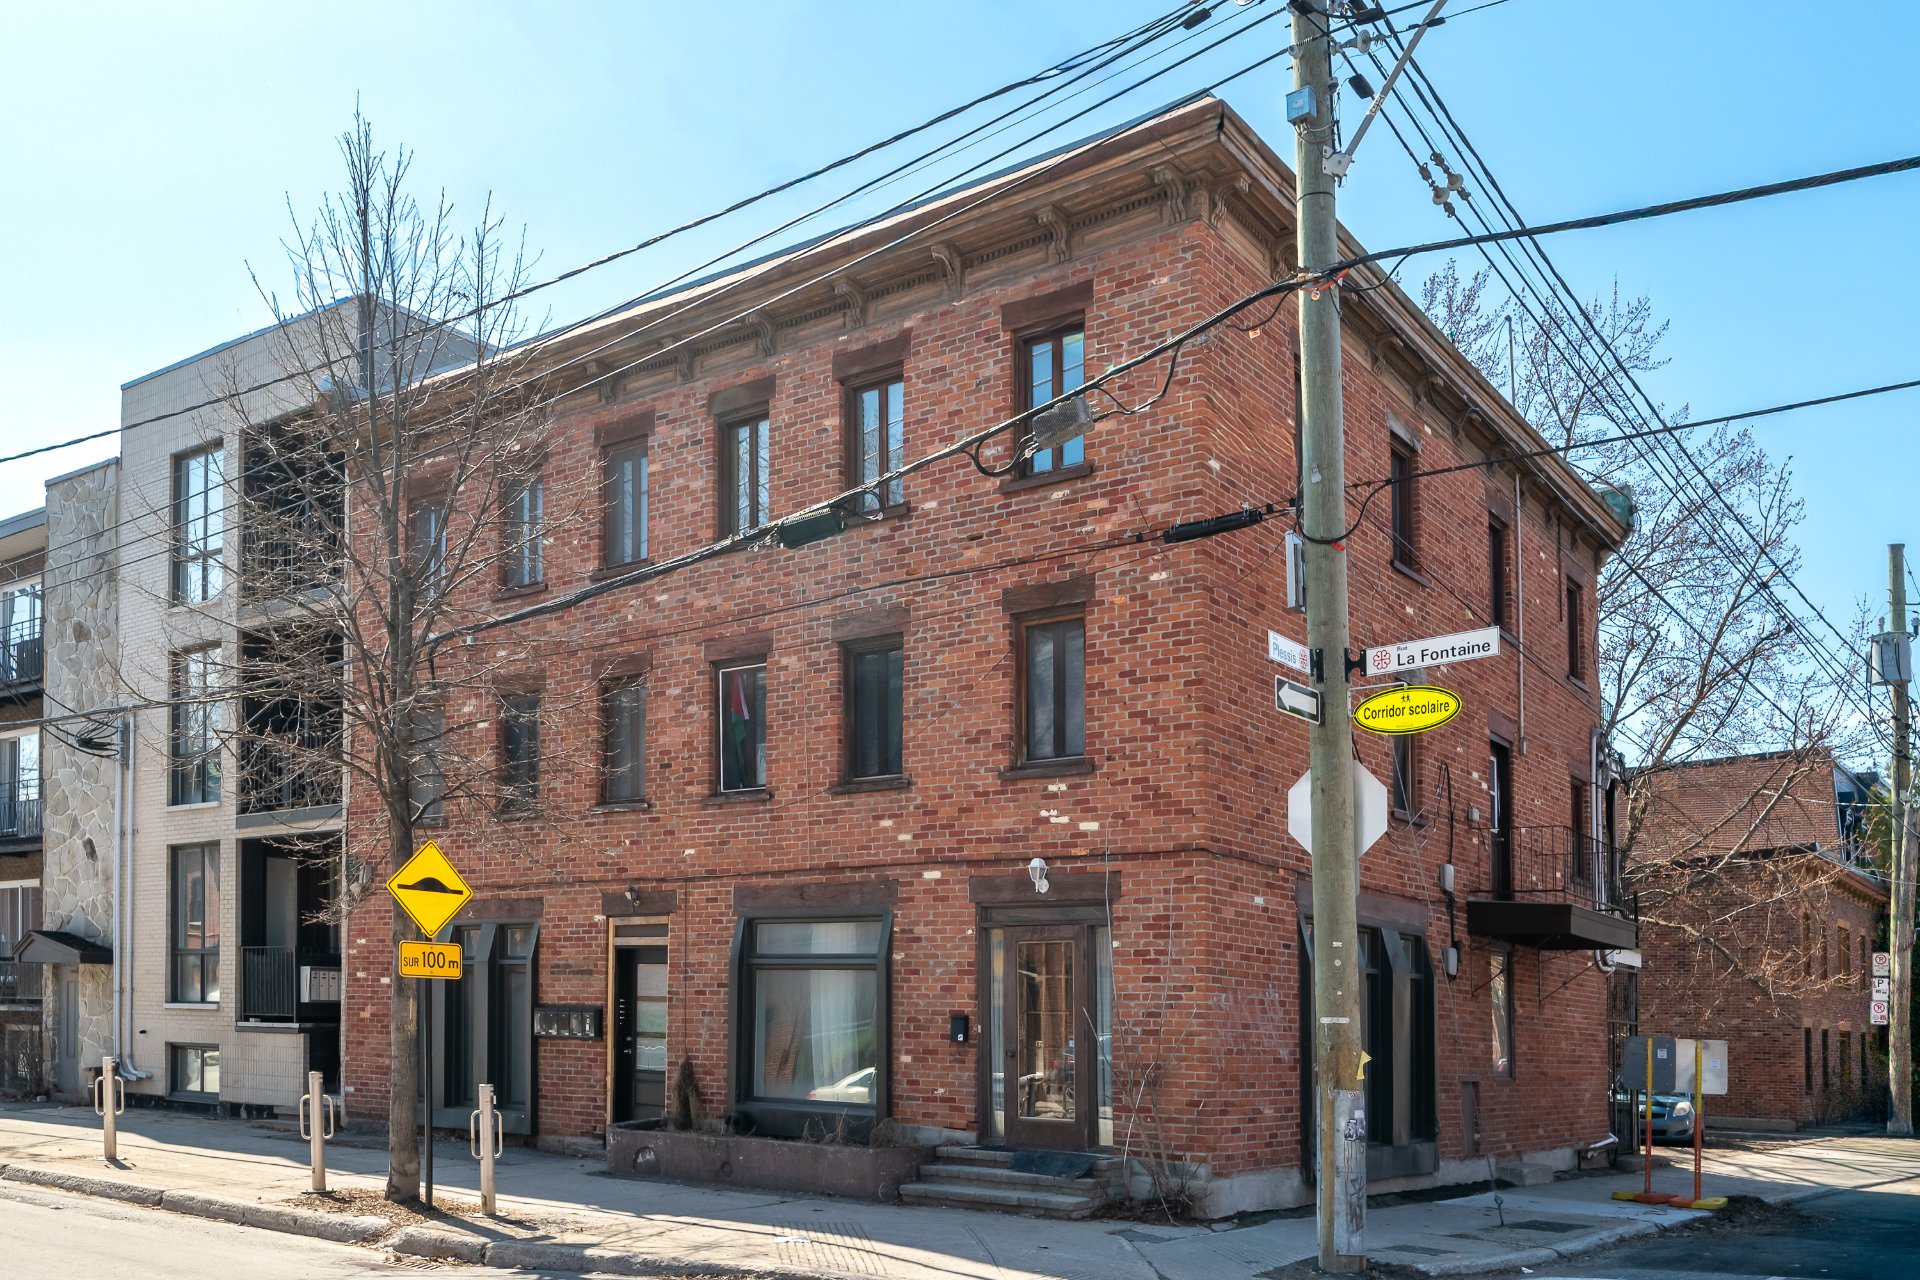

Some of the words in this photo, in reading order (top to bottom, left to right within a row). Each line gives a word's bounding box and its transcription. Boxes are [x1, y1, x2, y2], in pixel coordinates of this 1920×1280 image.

[1272, 642, 1297, 664] Plessis
[1397, 653, 1415, 667] La
[1421, 641, 1491, 663] Fontaine
[1363, 705, 1405, 720] Corridor
[1408, 700, 1450, 716] scolaire
[403, 956, 420, 967] SUR
[422, 951, 446, 968] 100
[448, 960, 459, 969] m
